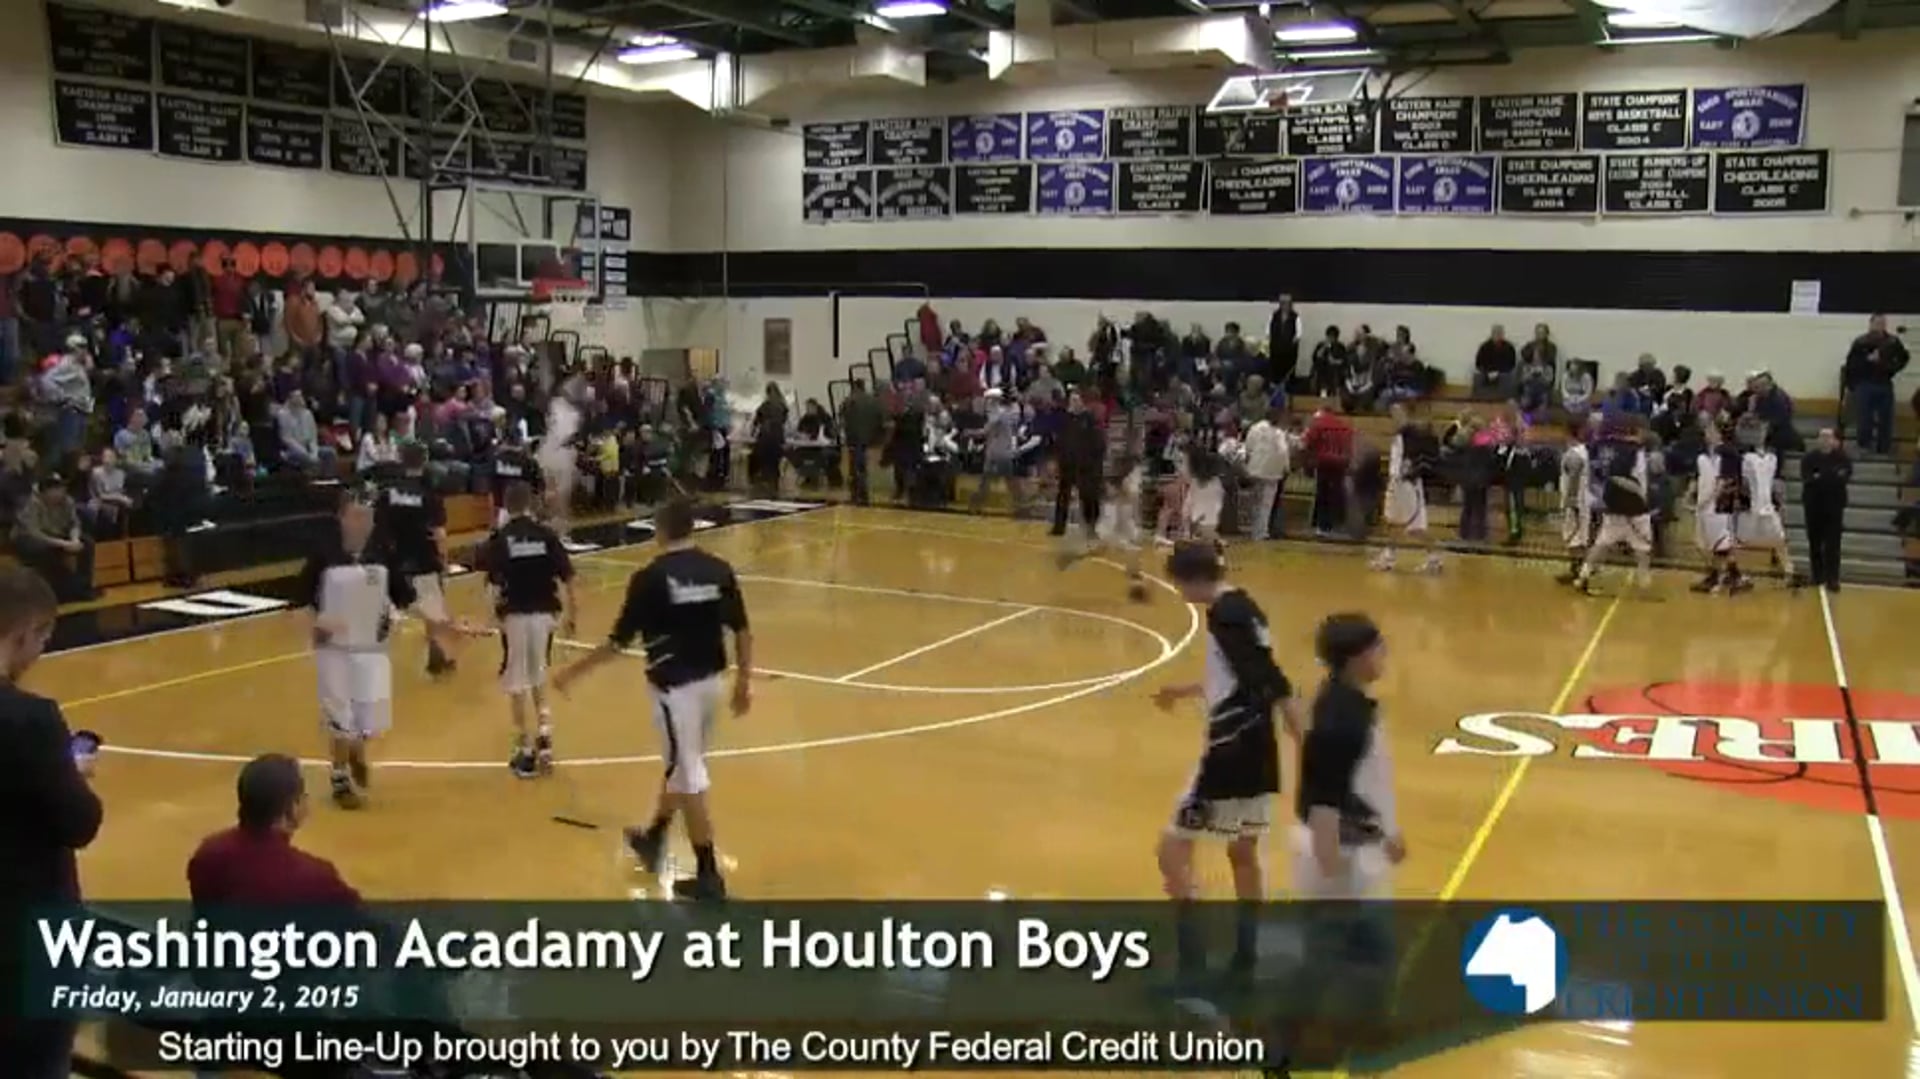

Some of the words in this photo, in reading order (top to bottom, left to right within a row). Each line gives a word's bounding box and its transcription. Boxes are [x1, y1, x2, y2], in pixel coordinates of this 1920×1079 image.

[1591, 96, 1621, 107] STATE
[1625, 94, 1681, 106] CHAMPIONS
[1396, 111, 1459, 121] CHAMPIONS
[1495, 107, 1561, 118] CHAMPIONS
[1588, 110, 1613, 121] BOYS
[1616, 108, 1681, 120] BASKETBALL
[1512, 128, 1571, 137] BASKETBALL
[1606, 123, 1649, 134] CLASS
[1652, 122, 1662, 132] C
[1402, 140, 1439, 149] CLASS
[1503, 139, 1542, 148] CLASS
[1616, 136, 1650, 145] 2004
[1507, 160, 1535, 171] STATE
[1540, 159, 1594, 170] CHAMPIONS
[1610, 157, 1639, 168] STATE
[1725, 156, 1757, 168] STATE
[1763, 154, 1819, 167] CHAMPIONS
[1505, 173, 1595, 184] CHEERLEADING
[1723, 169, 1819, 183] CHEERLEADING
[1523, 186, 1563, 196] CLASS
[1624, 190, 1689, 200] SOFTBALL
[1741, 185, 1785, 196] CLASS
[1789, 184, 1799, 194] C
[1629, 199, 1671, 209] CLASS
